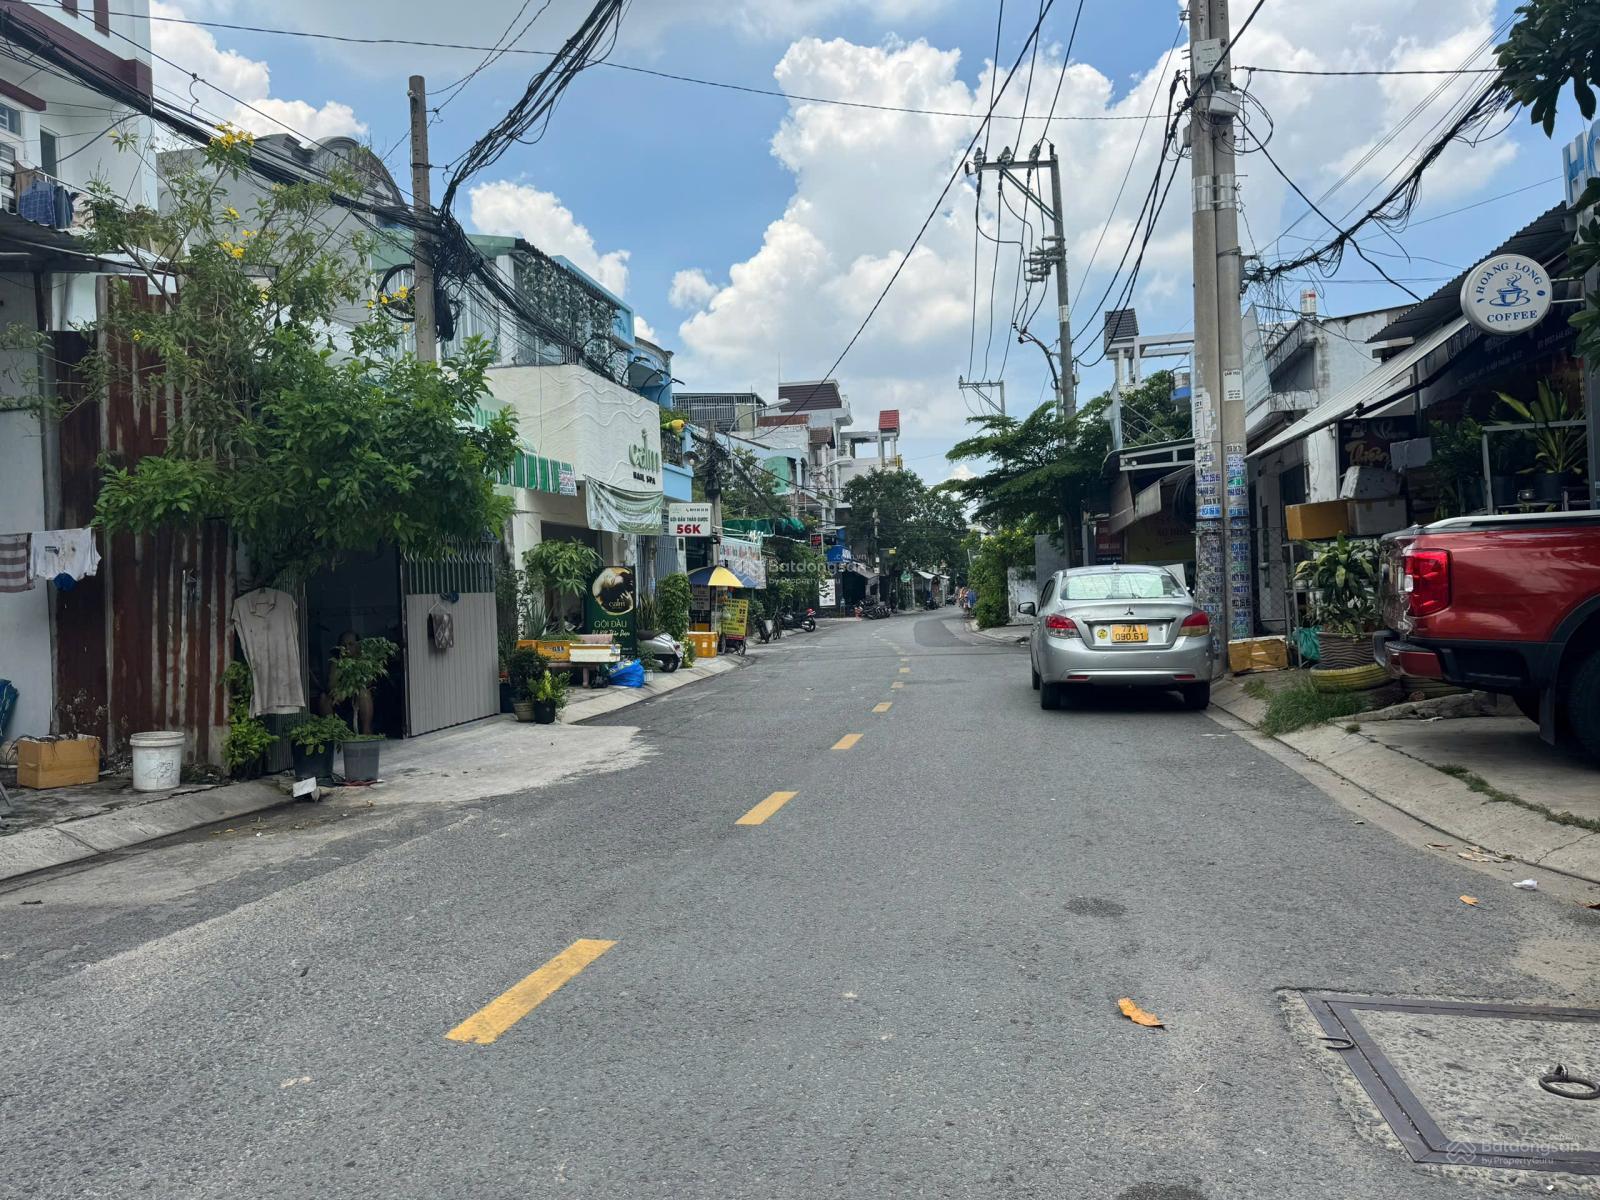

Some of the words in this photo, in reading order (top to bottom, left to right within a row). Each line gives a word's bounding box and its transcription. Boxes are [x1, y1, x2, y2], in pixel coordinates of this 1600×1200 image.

[1515, 262, 1542, 285] LONG
[1487, 310, 1538, 323] COFFEE
[646, 475, 656, 485] SPA
[676, 524, 702, 534] 56K
[1121, 624, 1138, 632] 77A
